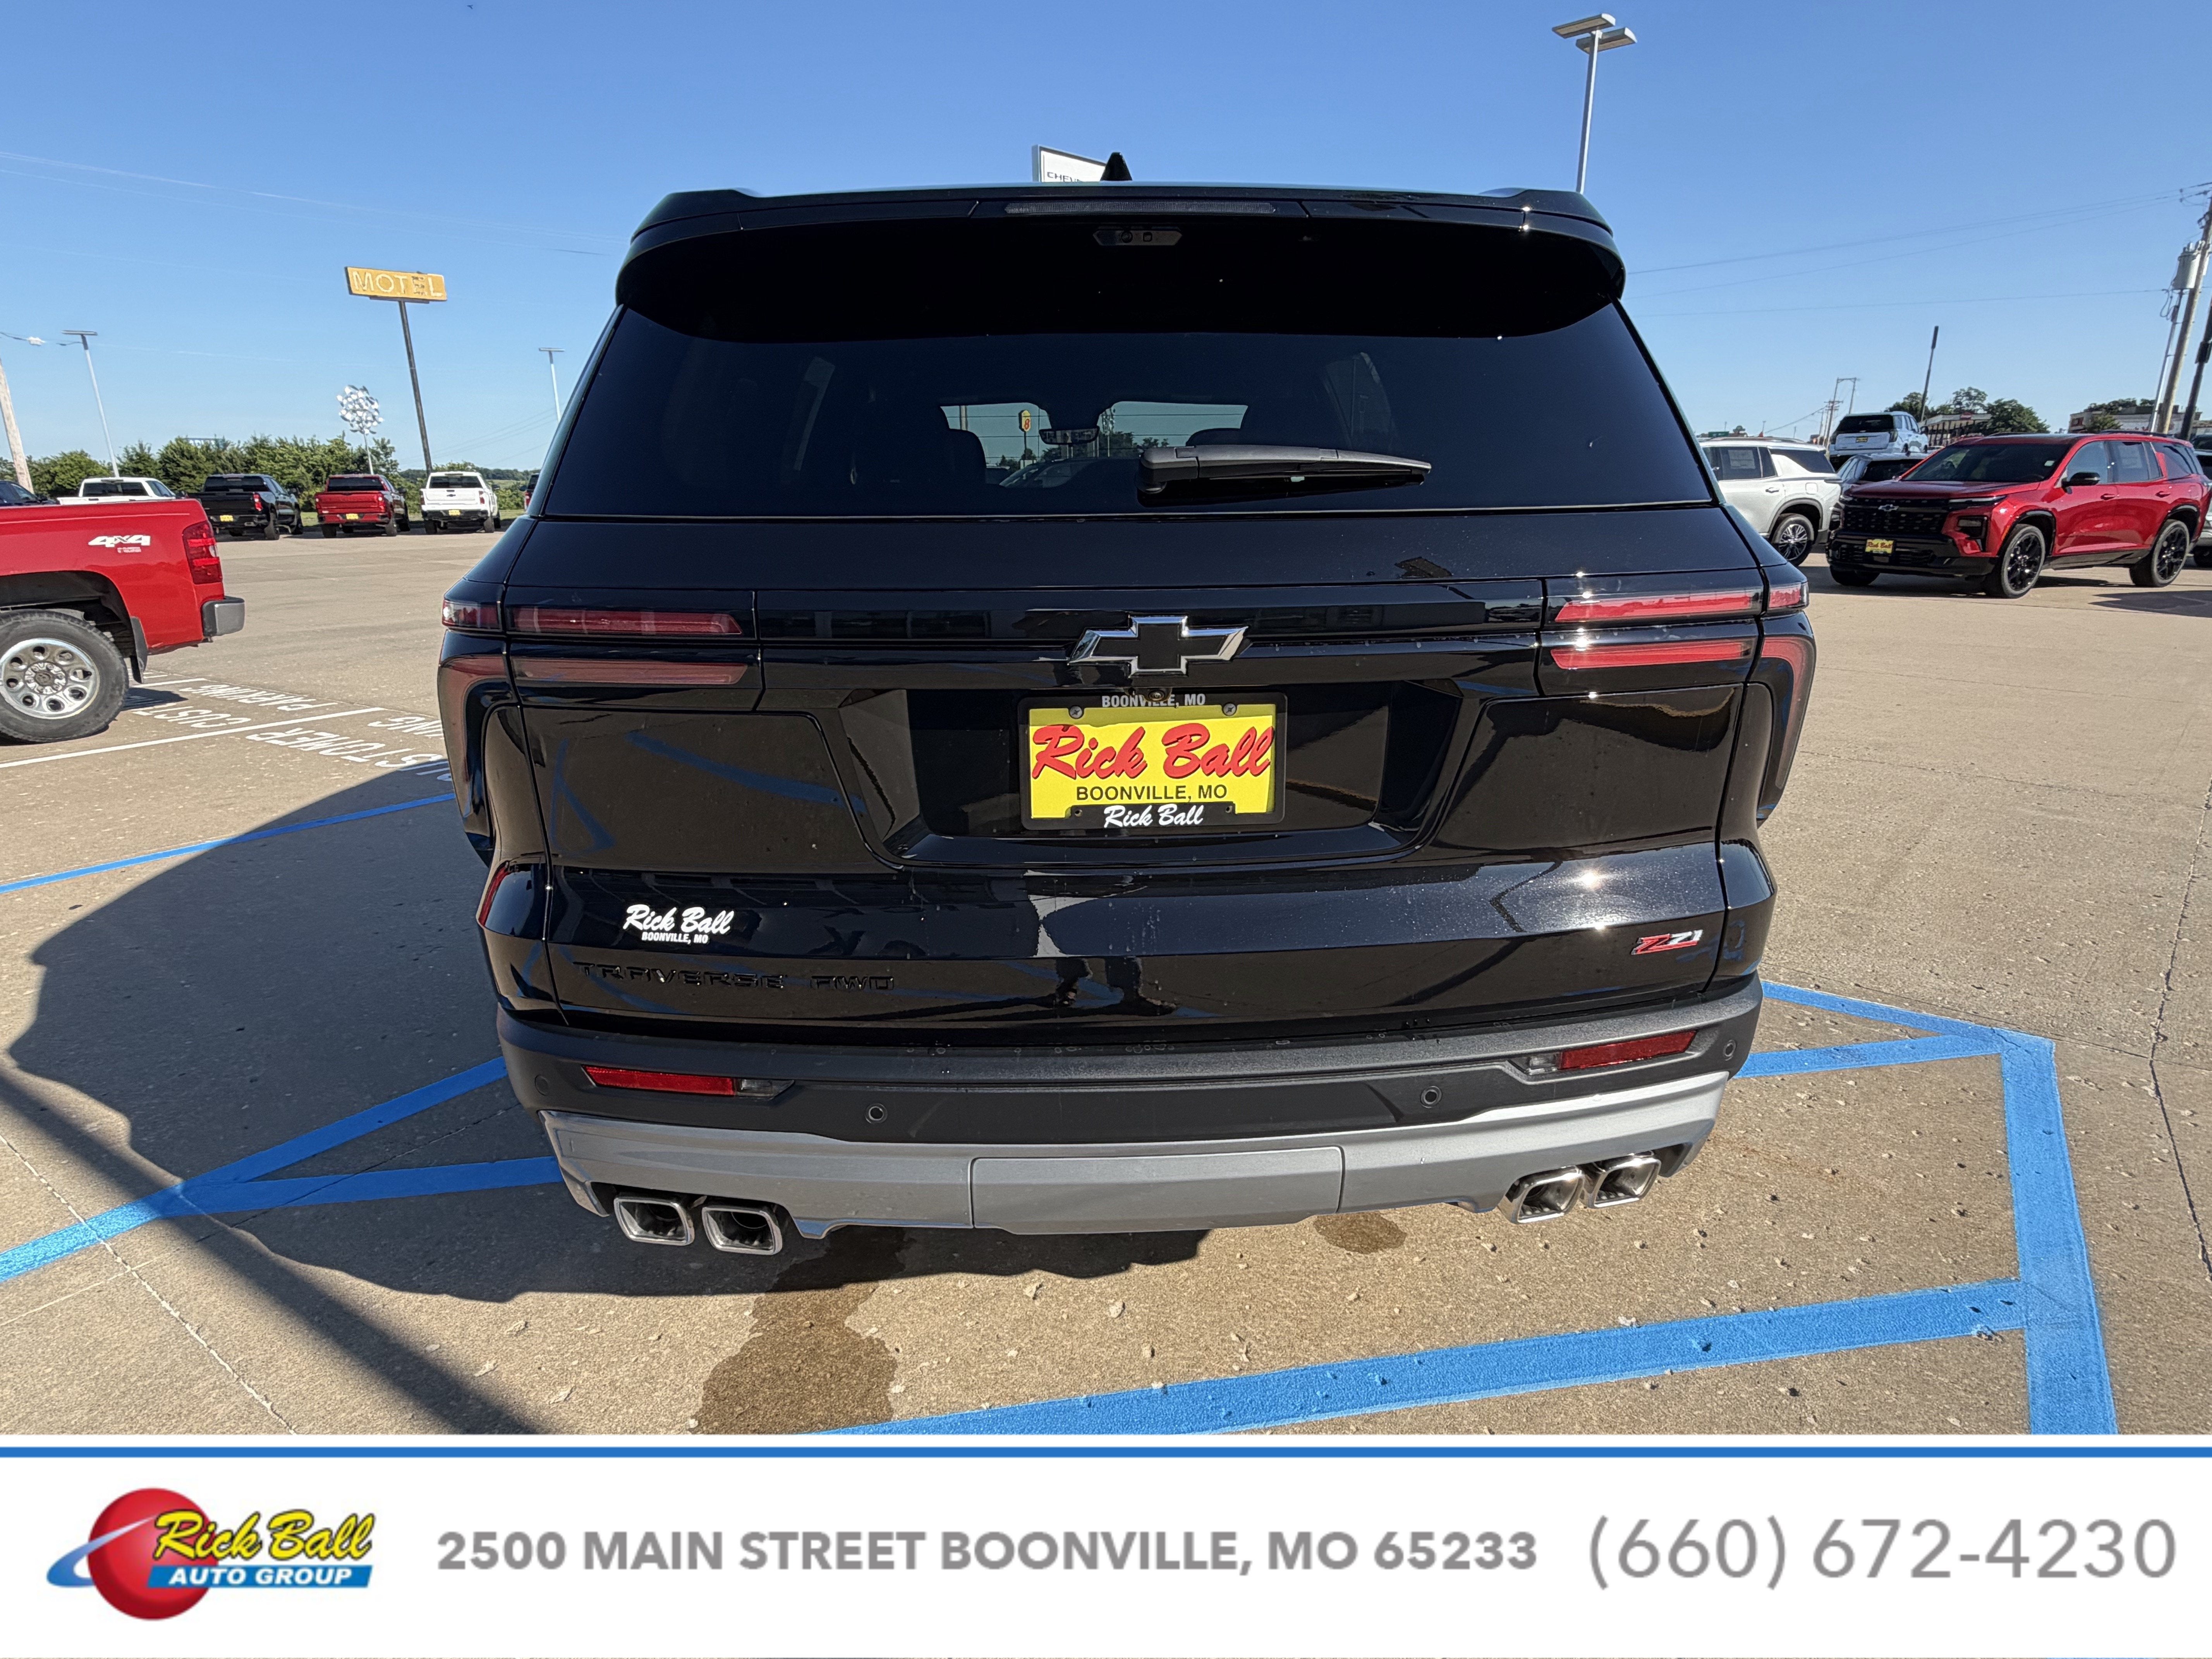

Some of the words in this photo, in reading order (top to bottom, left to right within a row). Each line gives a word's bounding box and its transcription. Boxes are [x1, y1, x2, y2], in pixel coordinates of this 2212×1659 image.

[352, 271, 442, 297] MOTEL
[179, 684, 338, 711] PARKING
[1184, 693, 1206, 706] MO
[1032, 724, 1147, 780] Rick
[1161, 723, 1274, 779] Ball
[1077, 785, 1191, 802] BOONVILLE,
[1198, 784, 1227, 799] MO
[1104, 805, 1154, 828] Rick
[1159, 805, 1204, 826] Ball
[623, 904, 677, 931] Rick
[680, 907, 734, 934] Ball
[641, 931, 691, 945] BOONVILLE,
[694, 934, 708, 944] MO
[1631, 930, 1704, 955] Z71
[572, 961, 785, 989] TRAVERSE
[811, 975, 895, 991] AWD
